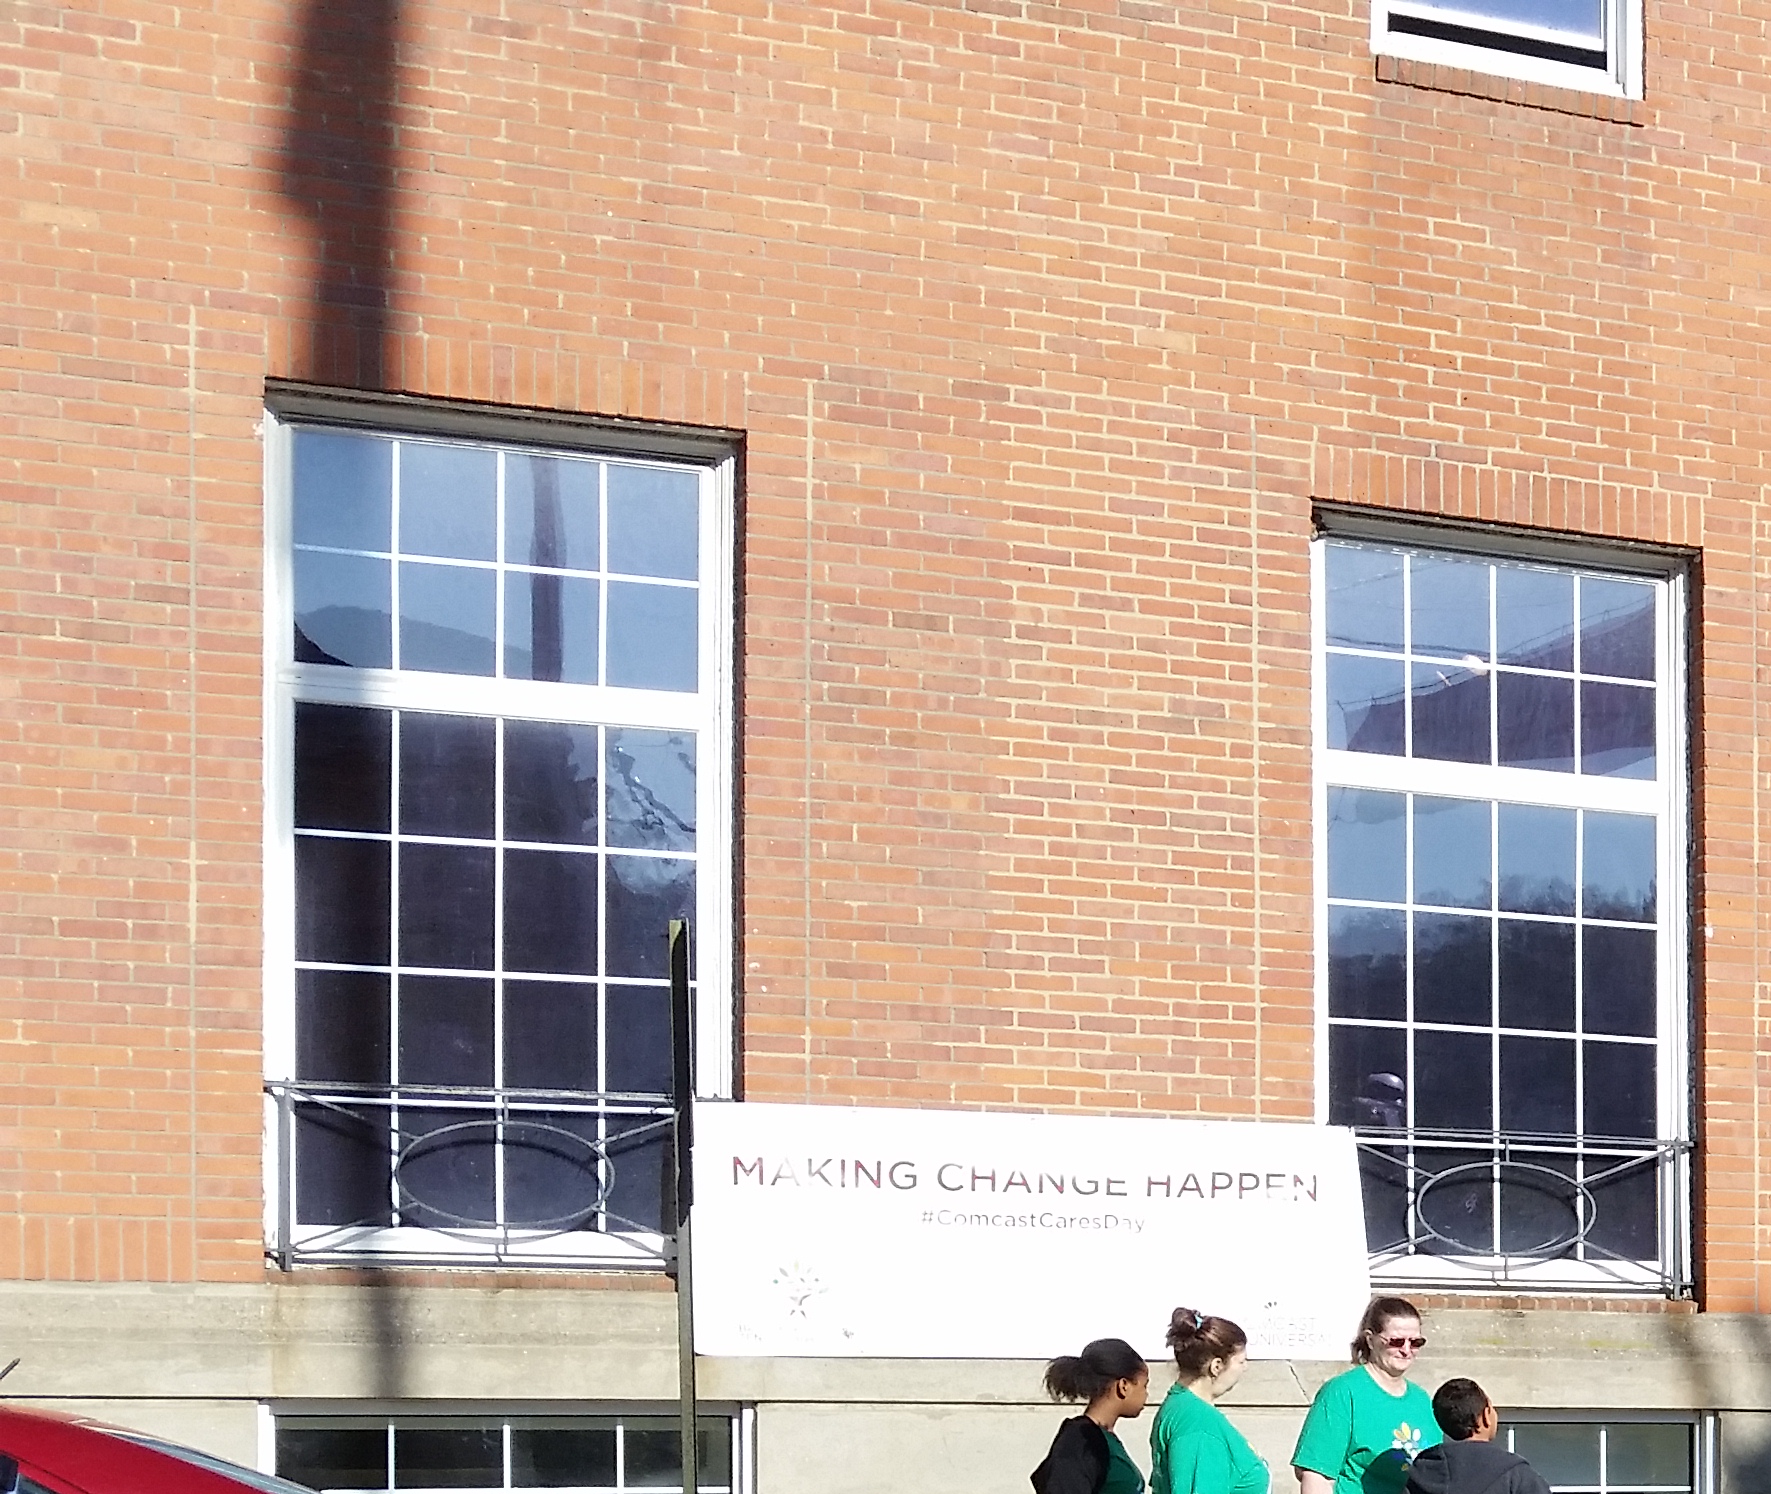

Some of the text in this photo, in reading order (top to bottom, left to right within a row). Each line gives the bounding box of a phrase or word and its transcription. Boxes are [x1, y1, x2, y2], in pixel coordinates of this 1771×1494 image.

[732, 1155, 1318, 1203] MAKING CHANGE HAPPEN
[921, 1209, 1146, 1234] #ComcastCaresDay
